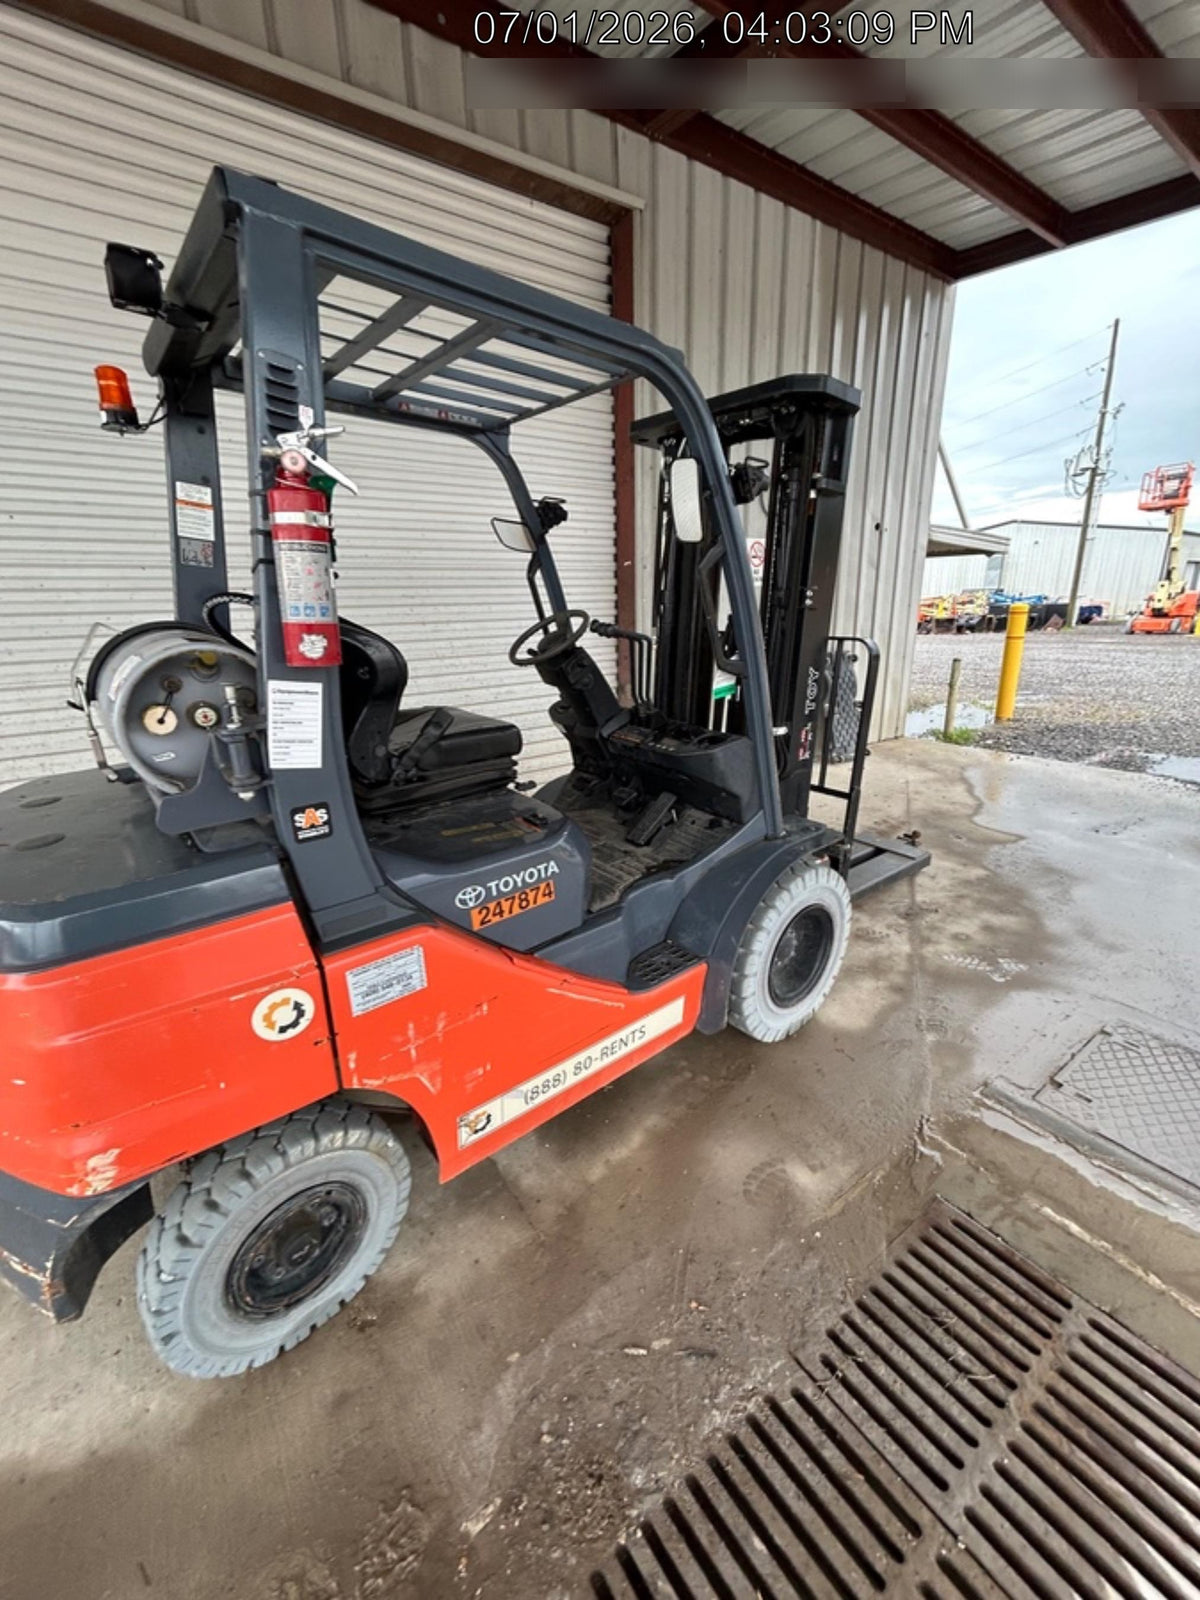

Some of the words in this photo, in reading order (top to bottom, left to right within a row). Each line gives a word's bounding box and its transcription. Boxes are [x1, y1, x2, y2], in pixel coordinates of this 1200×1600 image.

[293, 807, 329, 829] SAS
[487, 860, 560, 896] TOYOTA
[477, 881, 553, 927] 247874
[523, 1069, 568, 1106] (888)
[572, 1024, 647, 1078] 80-RENTS
